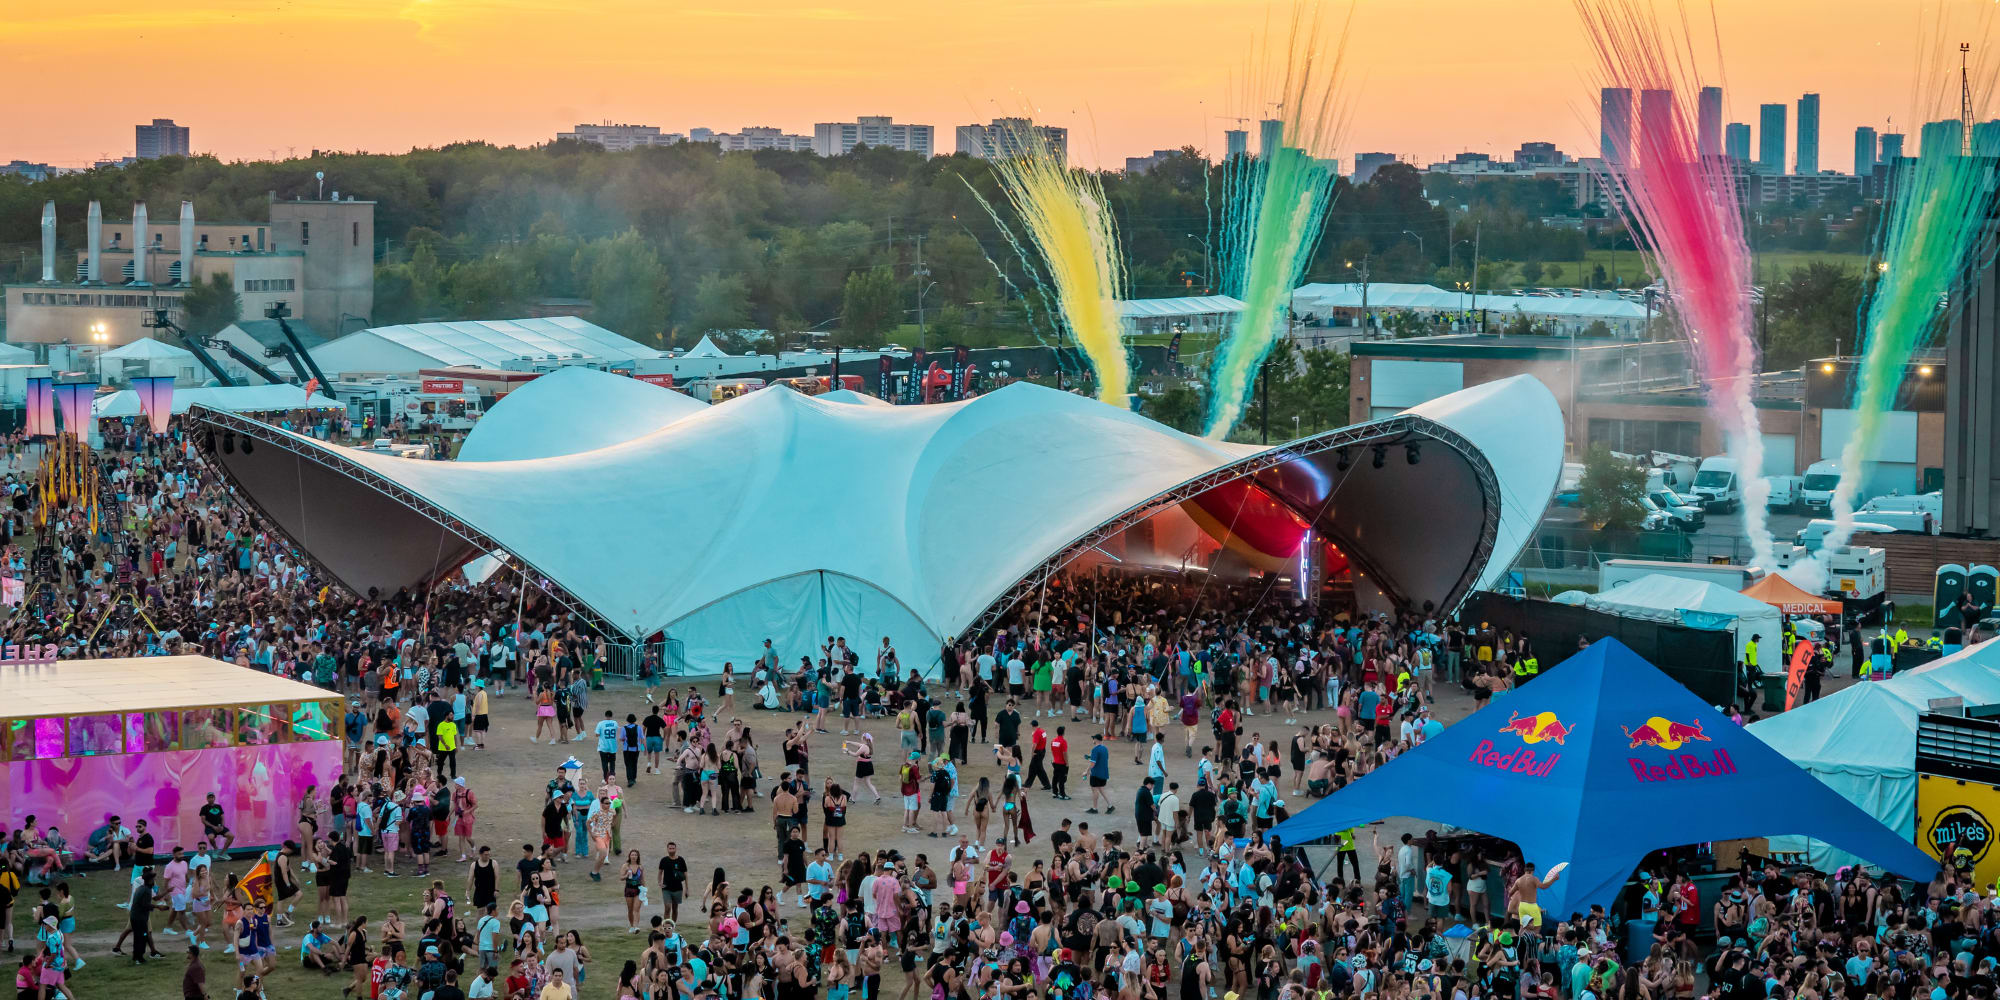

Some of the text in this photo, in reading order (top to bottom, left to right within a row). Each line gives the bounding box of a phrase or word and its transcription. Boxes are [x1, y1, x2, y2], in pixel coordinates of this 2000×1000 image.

[1782, 602, 1827, 613] MEDICAL
[1788, 648, 1812, 699] BAR
[605, 729, 616, 739] 99
[1469, 739, 1561, 778] Red Bull
[1628, 748, 1738, 783] Red Bull
[1936, 821, 1985, 844] mike's
[1405, 958, 1417, 974] 23
